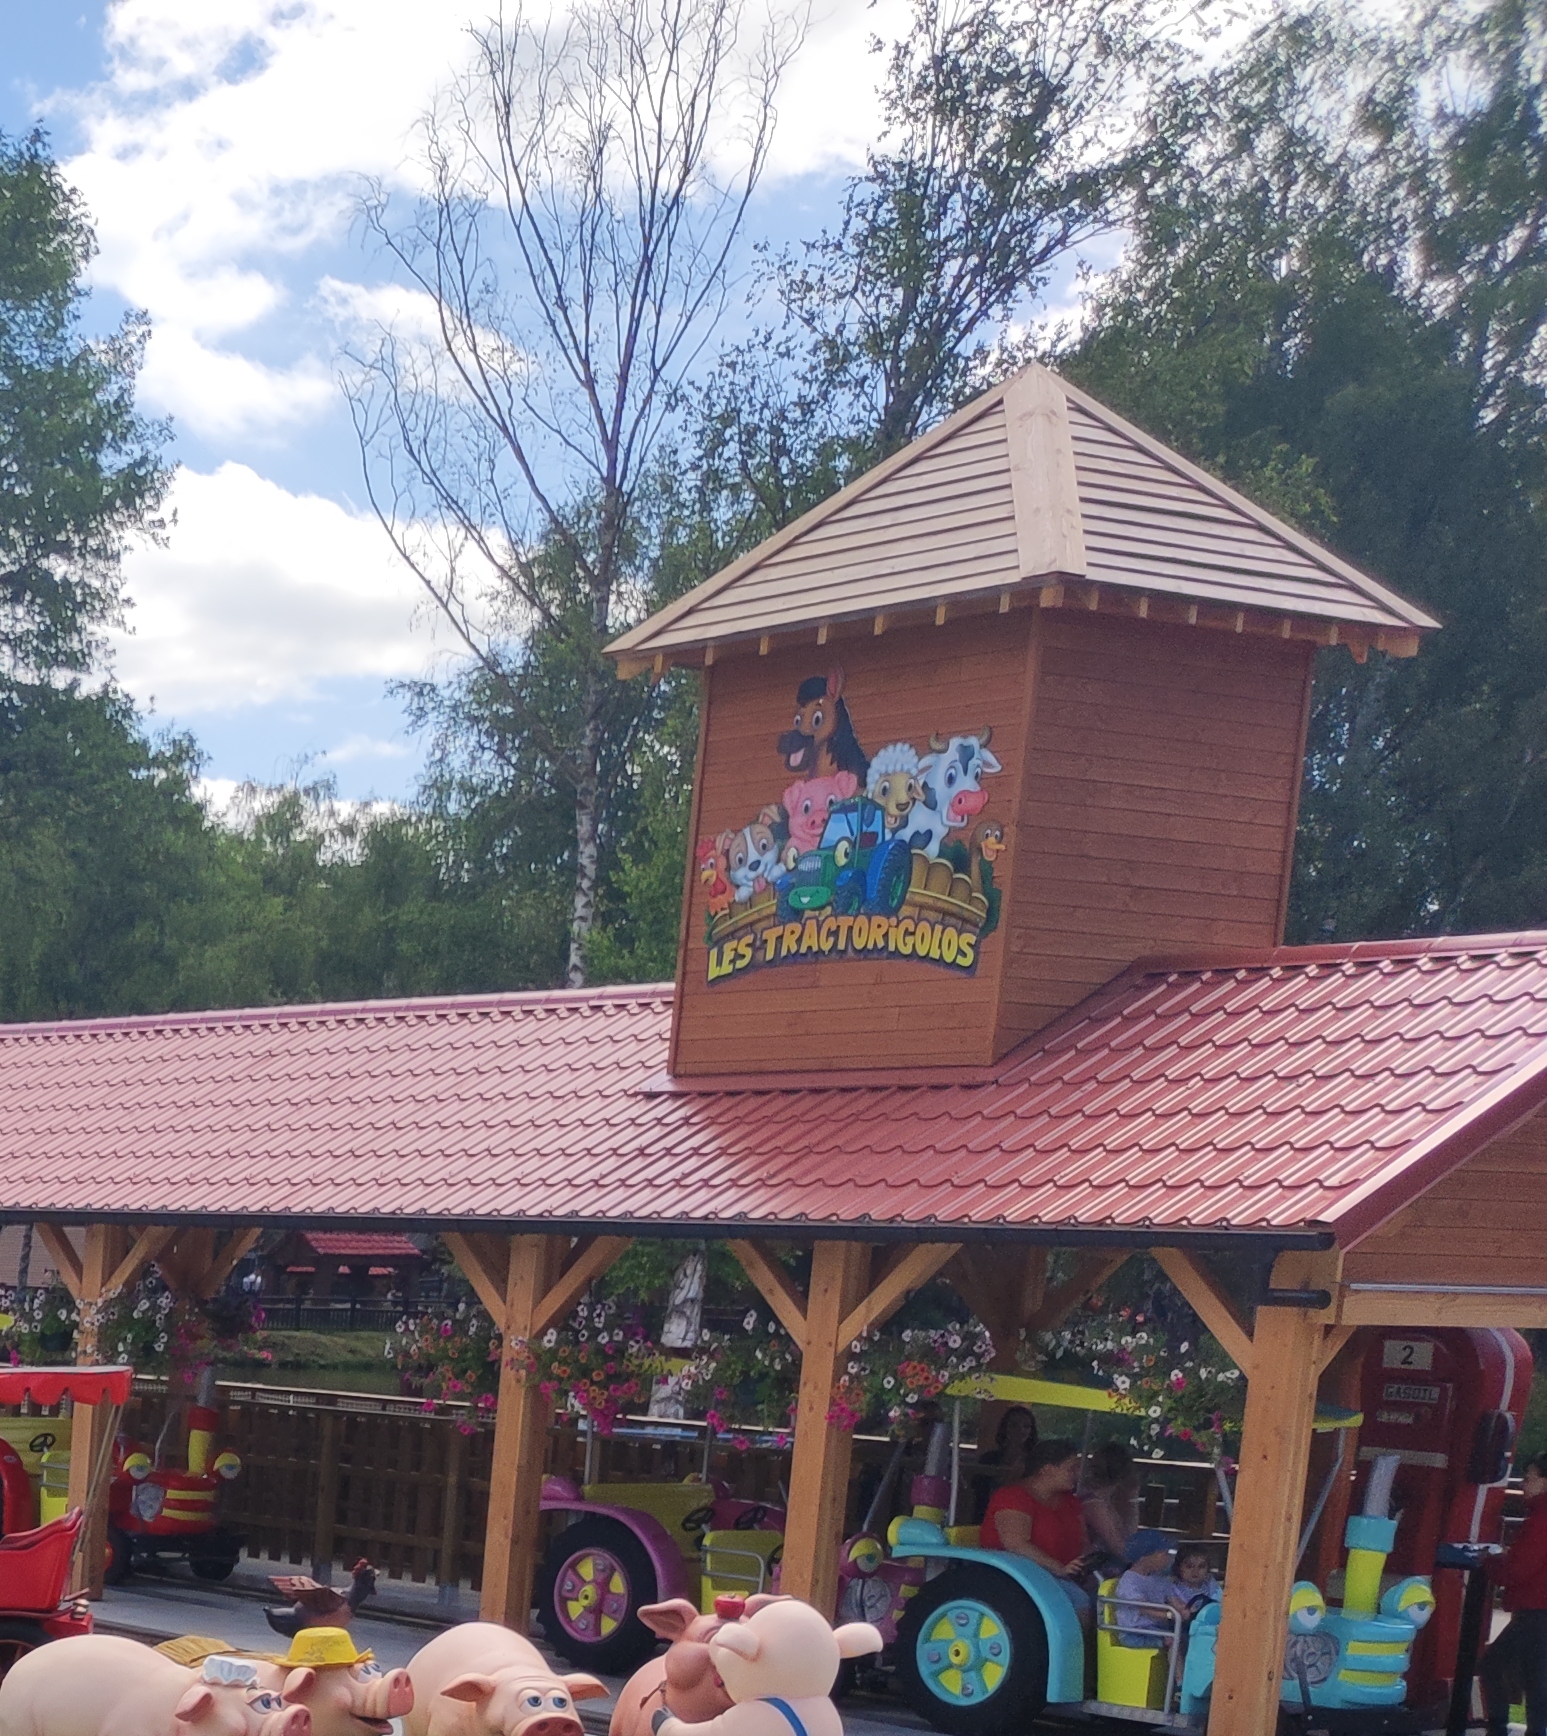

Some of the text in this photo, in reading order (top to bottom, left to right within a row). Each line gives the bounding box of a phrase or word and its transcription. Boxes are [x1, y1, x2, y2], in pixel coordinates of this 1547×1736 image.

[707, 934, 755, 982] LES
[1400, 1344, 1415, 1366] 2
[1385, 1385, 1439, 1401] GASOIL
